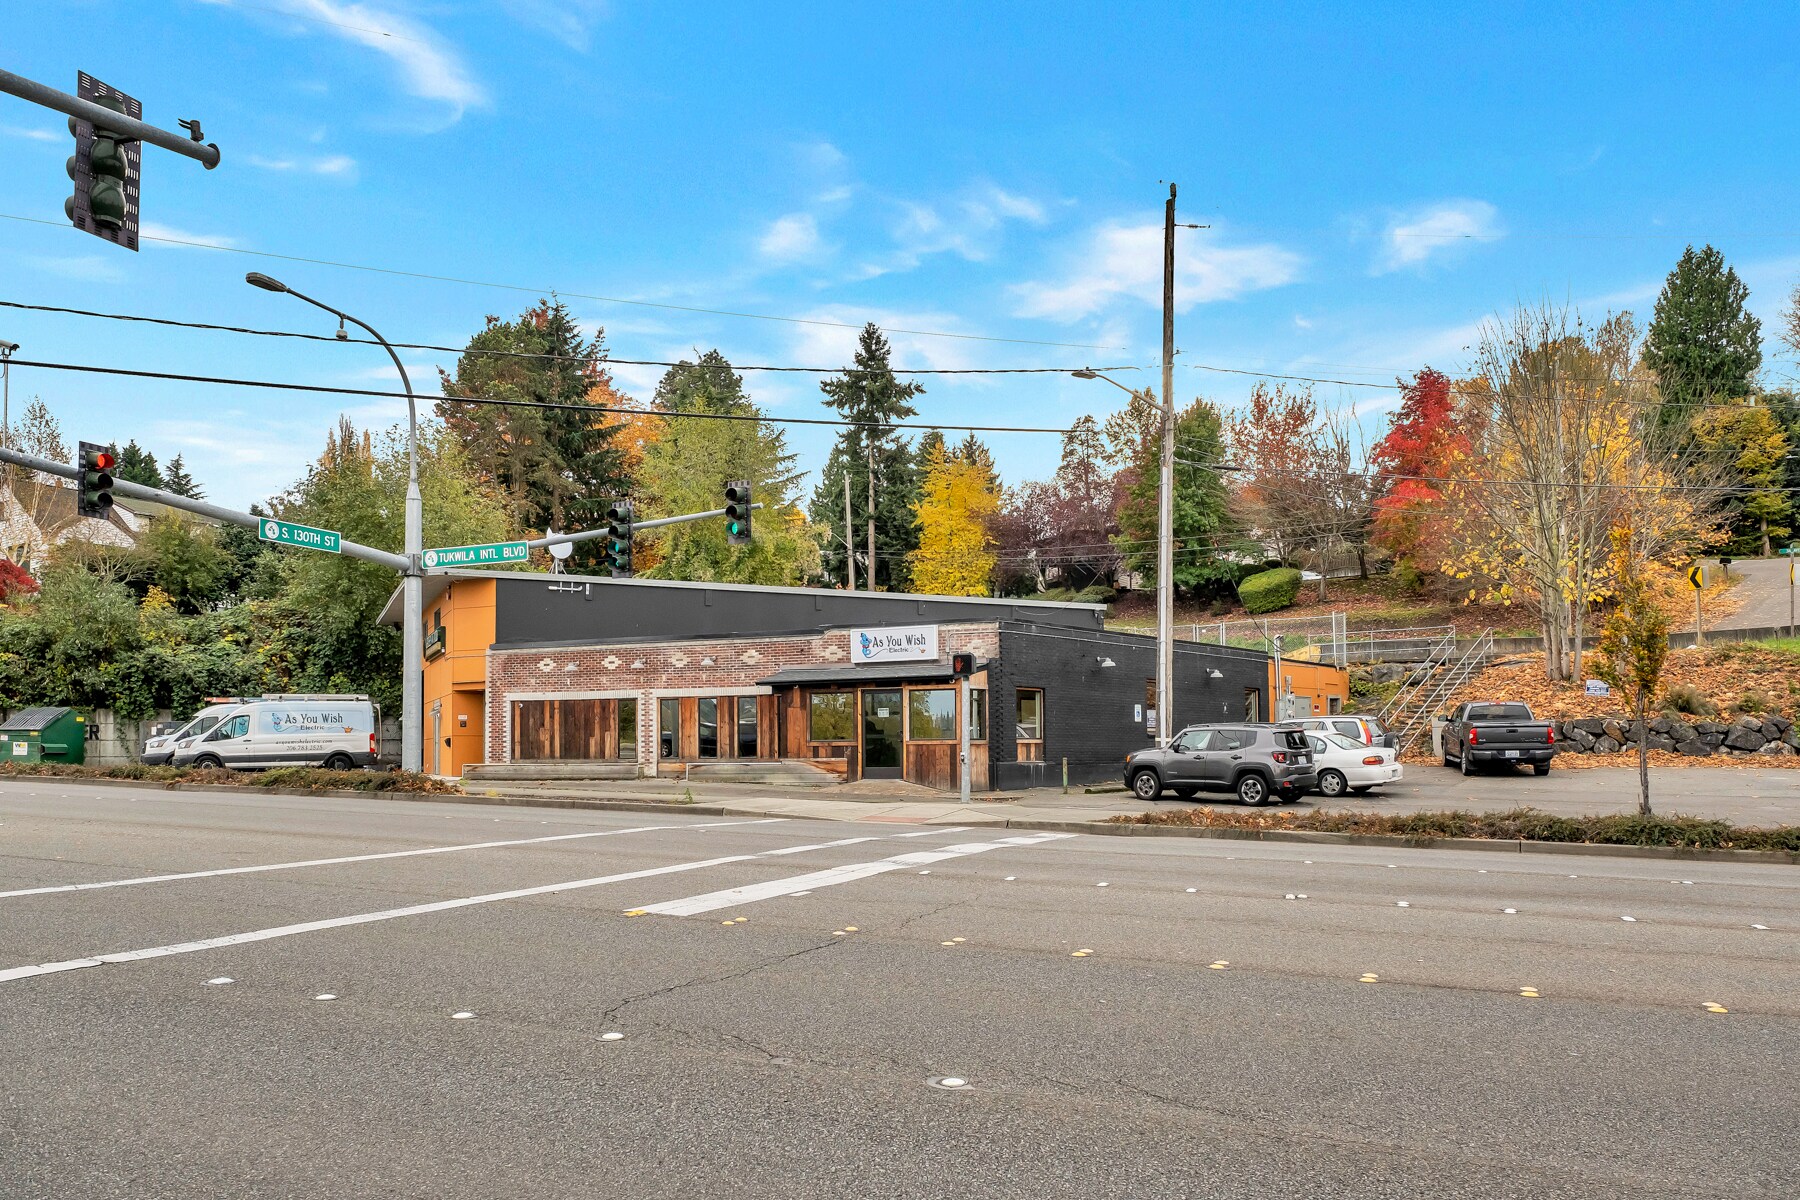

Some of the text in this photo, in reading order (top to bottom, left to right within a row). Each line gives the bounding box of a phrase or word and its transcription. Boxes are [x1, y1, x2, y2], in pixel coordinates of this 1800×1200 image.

[281, 527, 335, 547] S. 130TH ST
[439, 546, 525, 562] TUKWILA INTL BLVD
[872, 633, 926, 648] As You Wish
[284, 712, 343, 724] As You Wish
